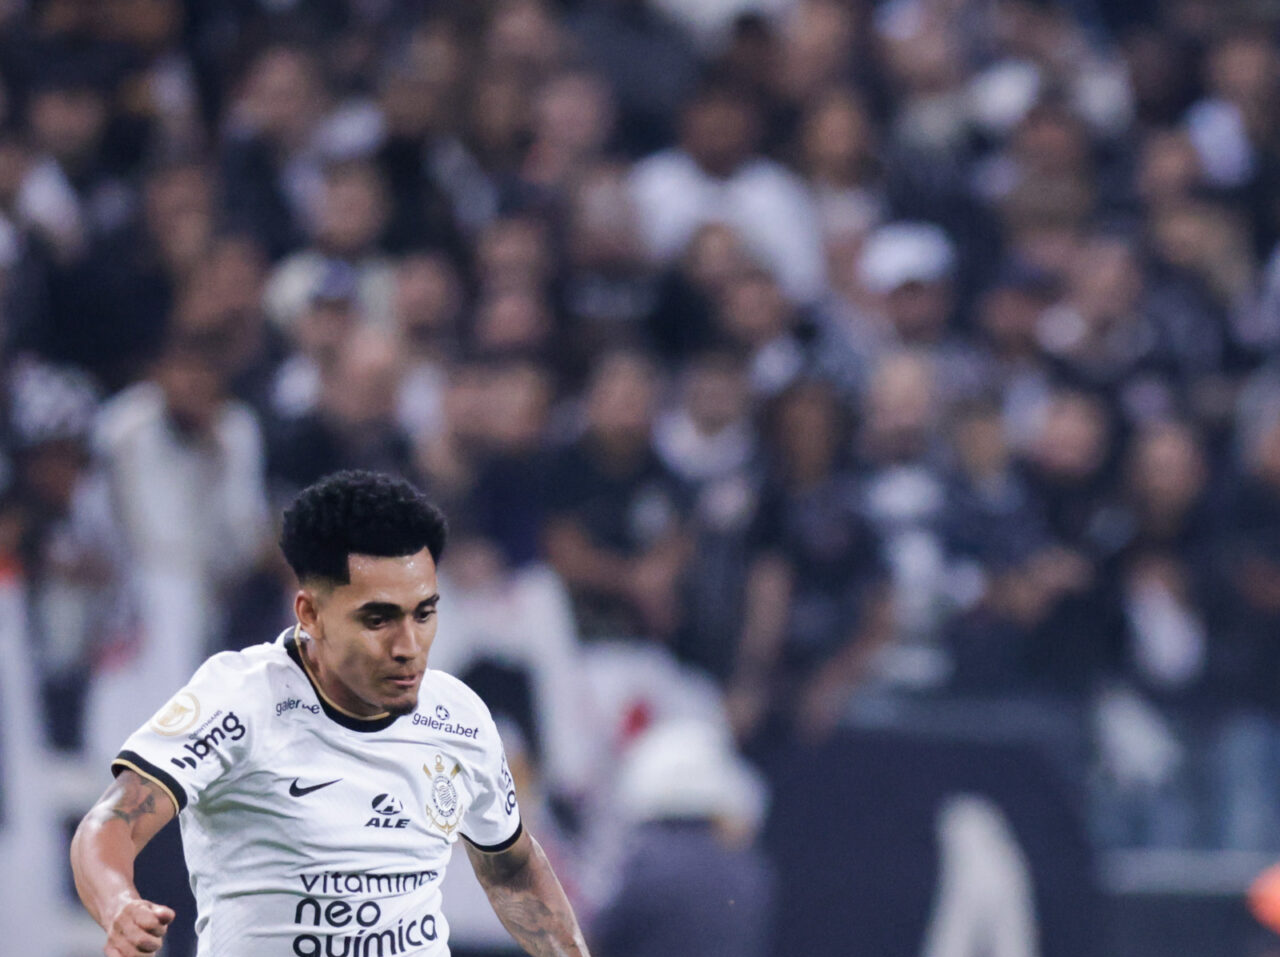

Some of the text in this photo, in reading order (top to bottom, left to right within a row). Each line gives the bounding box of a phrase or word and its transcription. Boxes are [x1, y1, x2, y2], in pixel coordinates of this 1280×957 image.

[184, 711, 246, 760] bmg
[412, 712, 480, 740] galera.bet
[364, 818, 411, 829] ALE
[294, 897, 381, 928] neo
